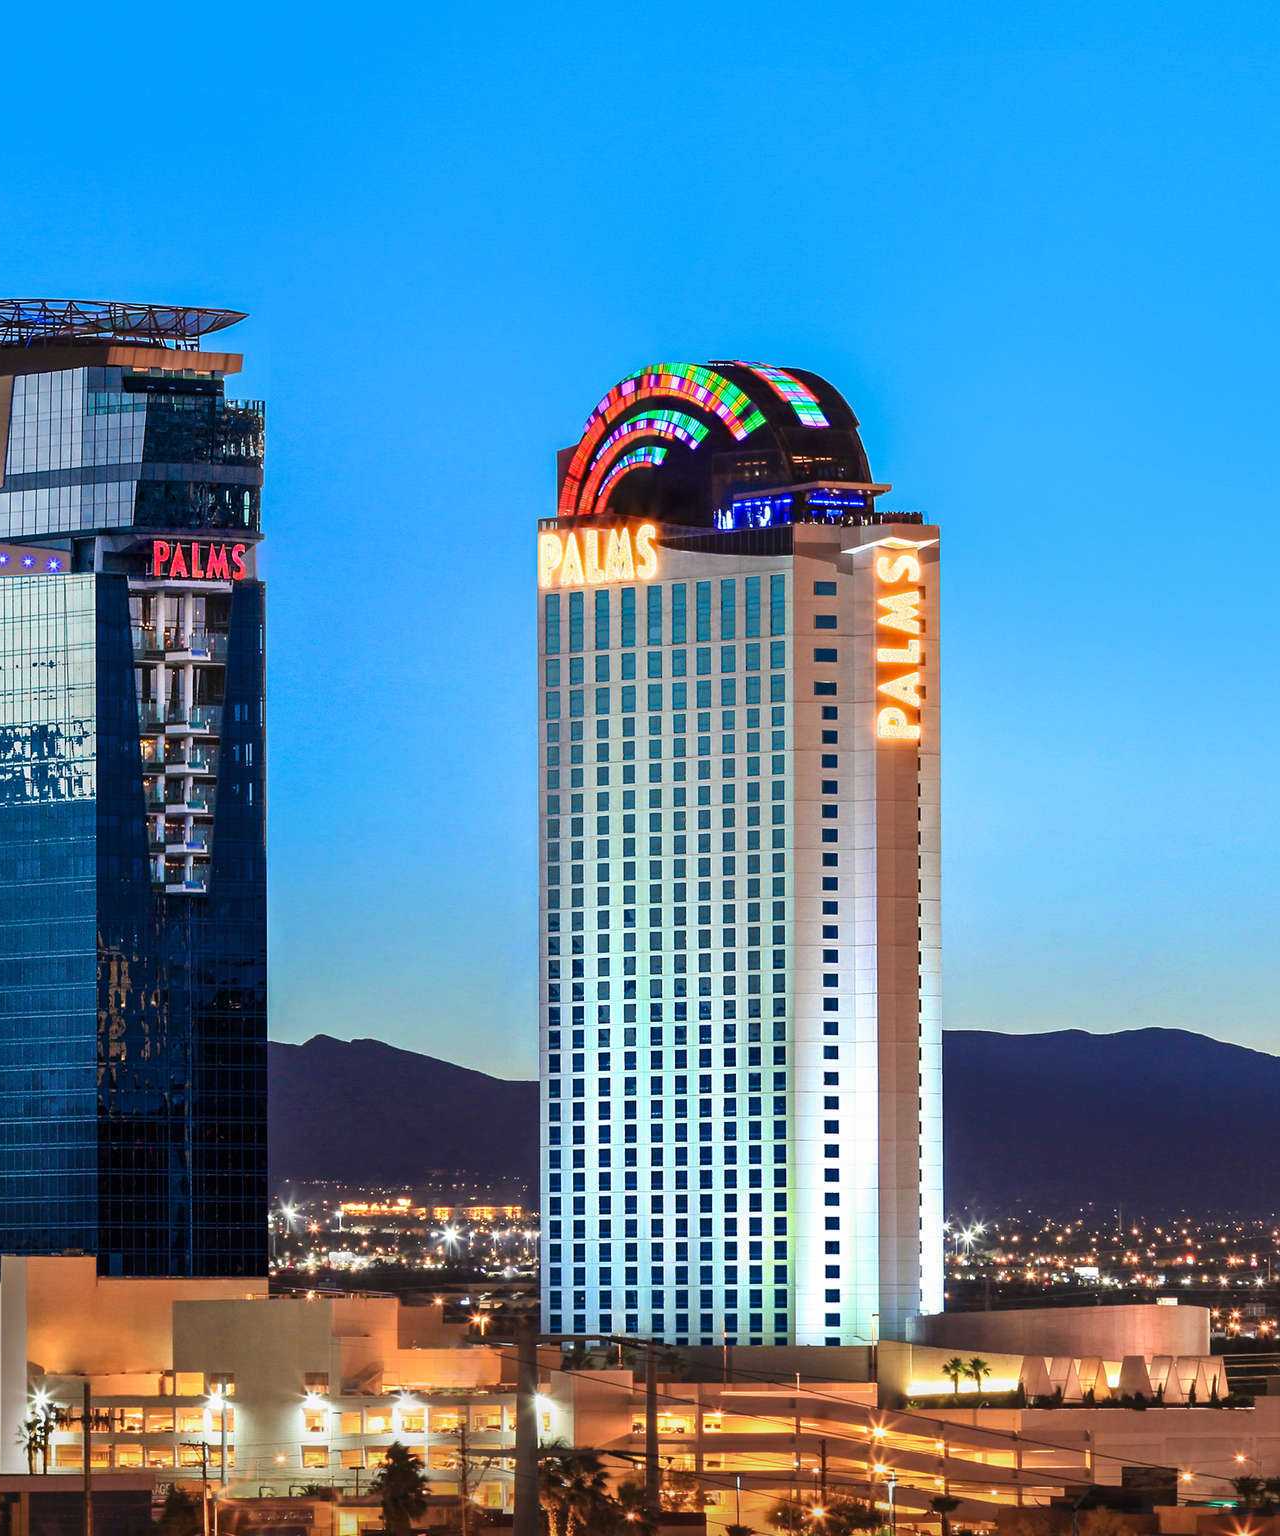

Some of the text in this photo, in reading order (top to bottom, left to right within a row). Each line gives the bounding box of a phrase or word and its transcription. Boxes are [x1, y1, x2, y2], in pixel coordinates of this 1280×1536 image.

[153, 540, 246, 580] PALMS
[539, 523, 658, 588] PALMS
[876, 554, 921, 739] PALMS
